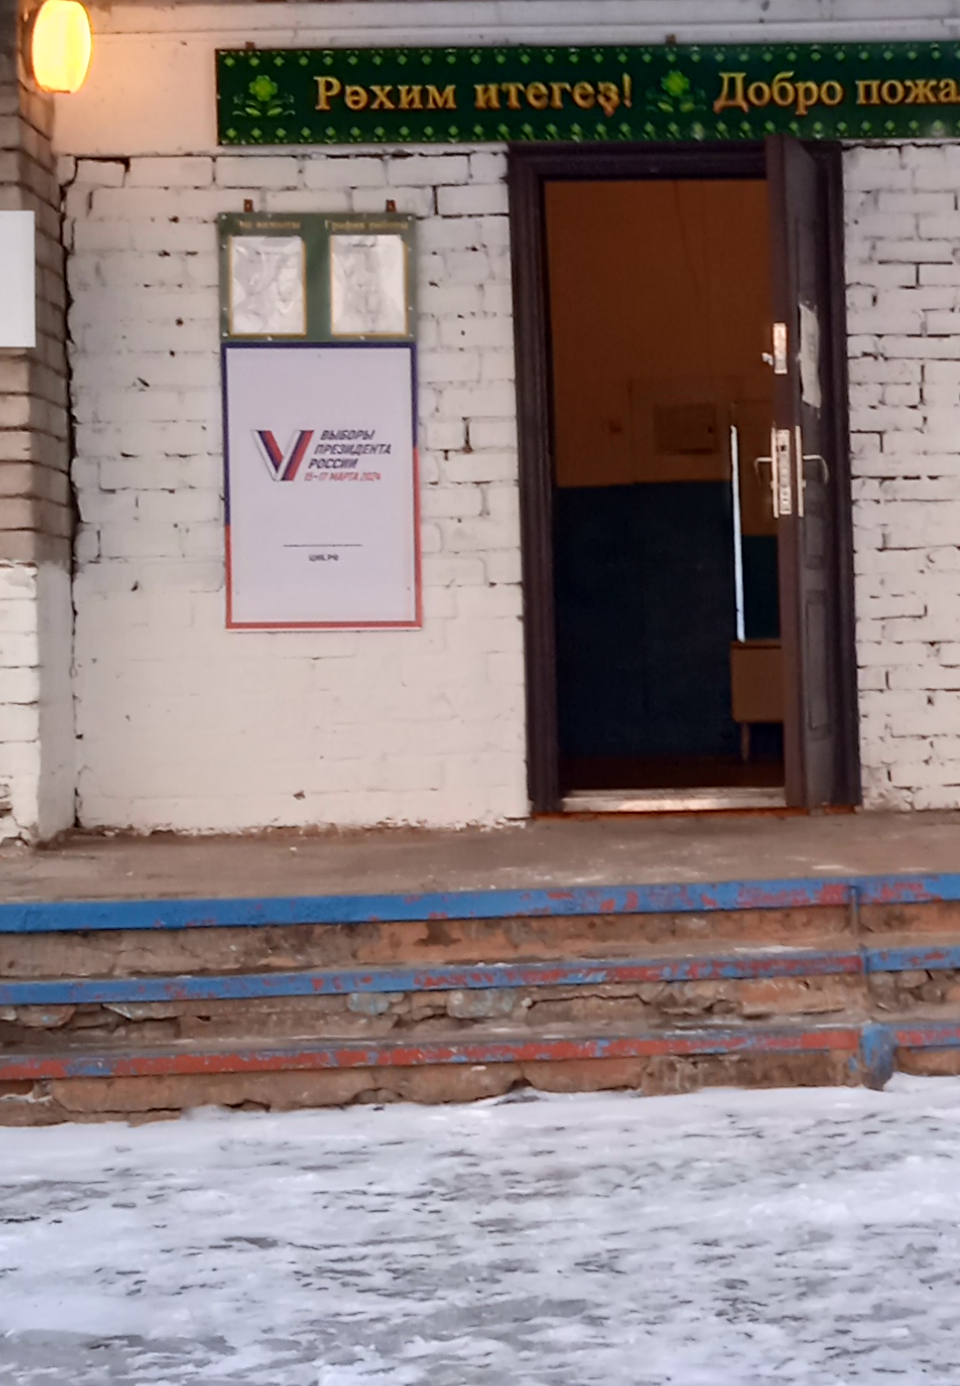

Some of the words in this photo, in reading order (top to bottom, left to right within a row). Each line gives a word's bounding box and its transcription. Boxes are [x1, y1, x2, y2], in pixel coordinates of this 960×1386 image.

[313, 76, 457, 111] Рәхим
[713, 71, 844, 115] Добро
[320, 429, 375, 441] ВЫБОРЫ
[314, 443, 392, 456] ПРЕЗИДЕНТА
[308, 458, 358, 470] РОССИИ
